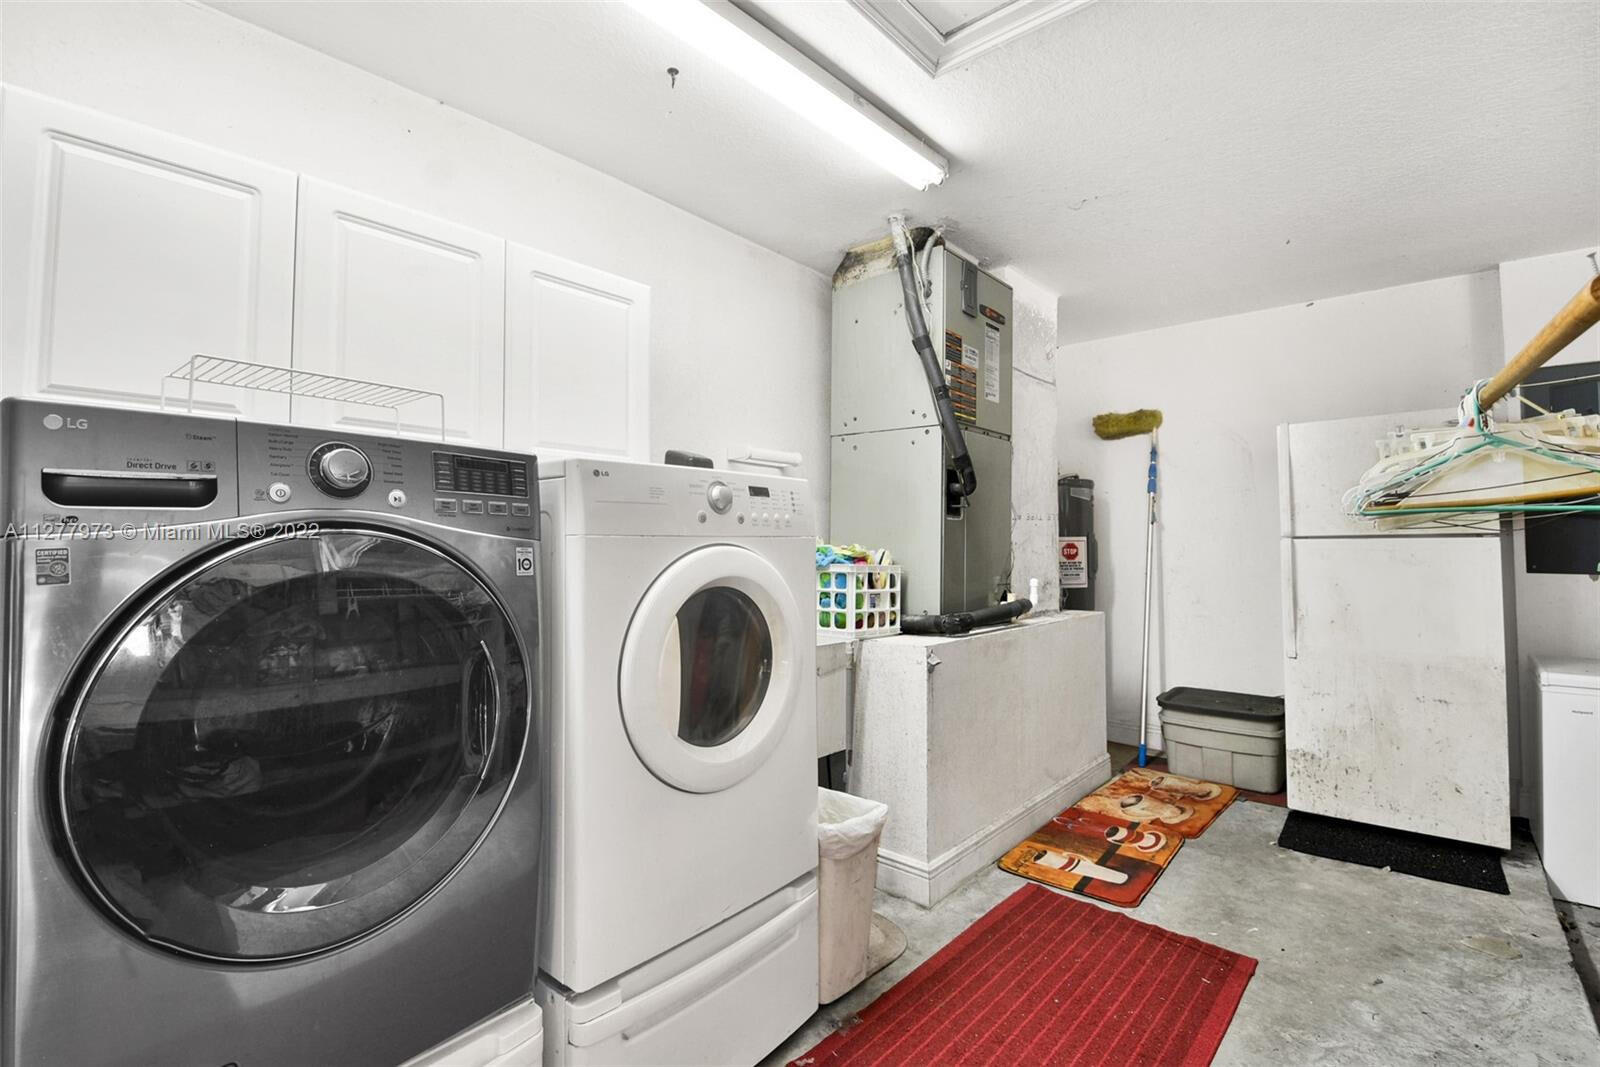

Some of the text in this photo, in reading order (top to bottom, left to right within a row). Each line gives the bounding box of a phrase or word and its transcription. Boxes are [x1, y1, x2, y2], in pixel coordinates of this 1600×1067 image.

[66, 417, 89, 430] LG
[126, 461, 177, 471] Direct Drive
[1063, 547, 1078, 556] STOP
